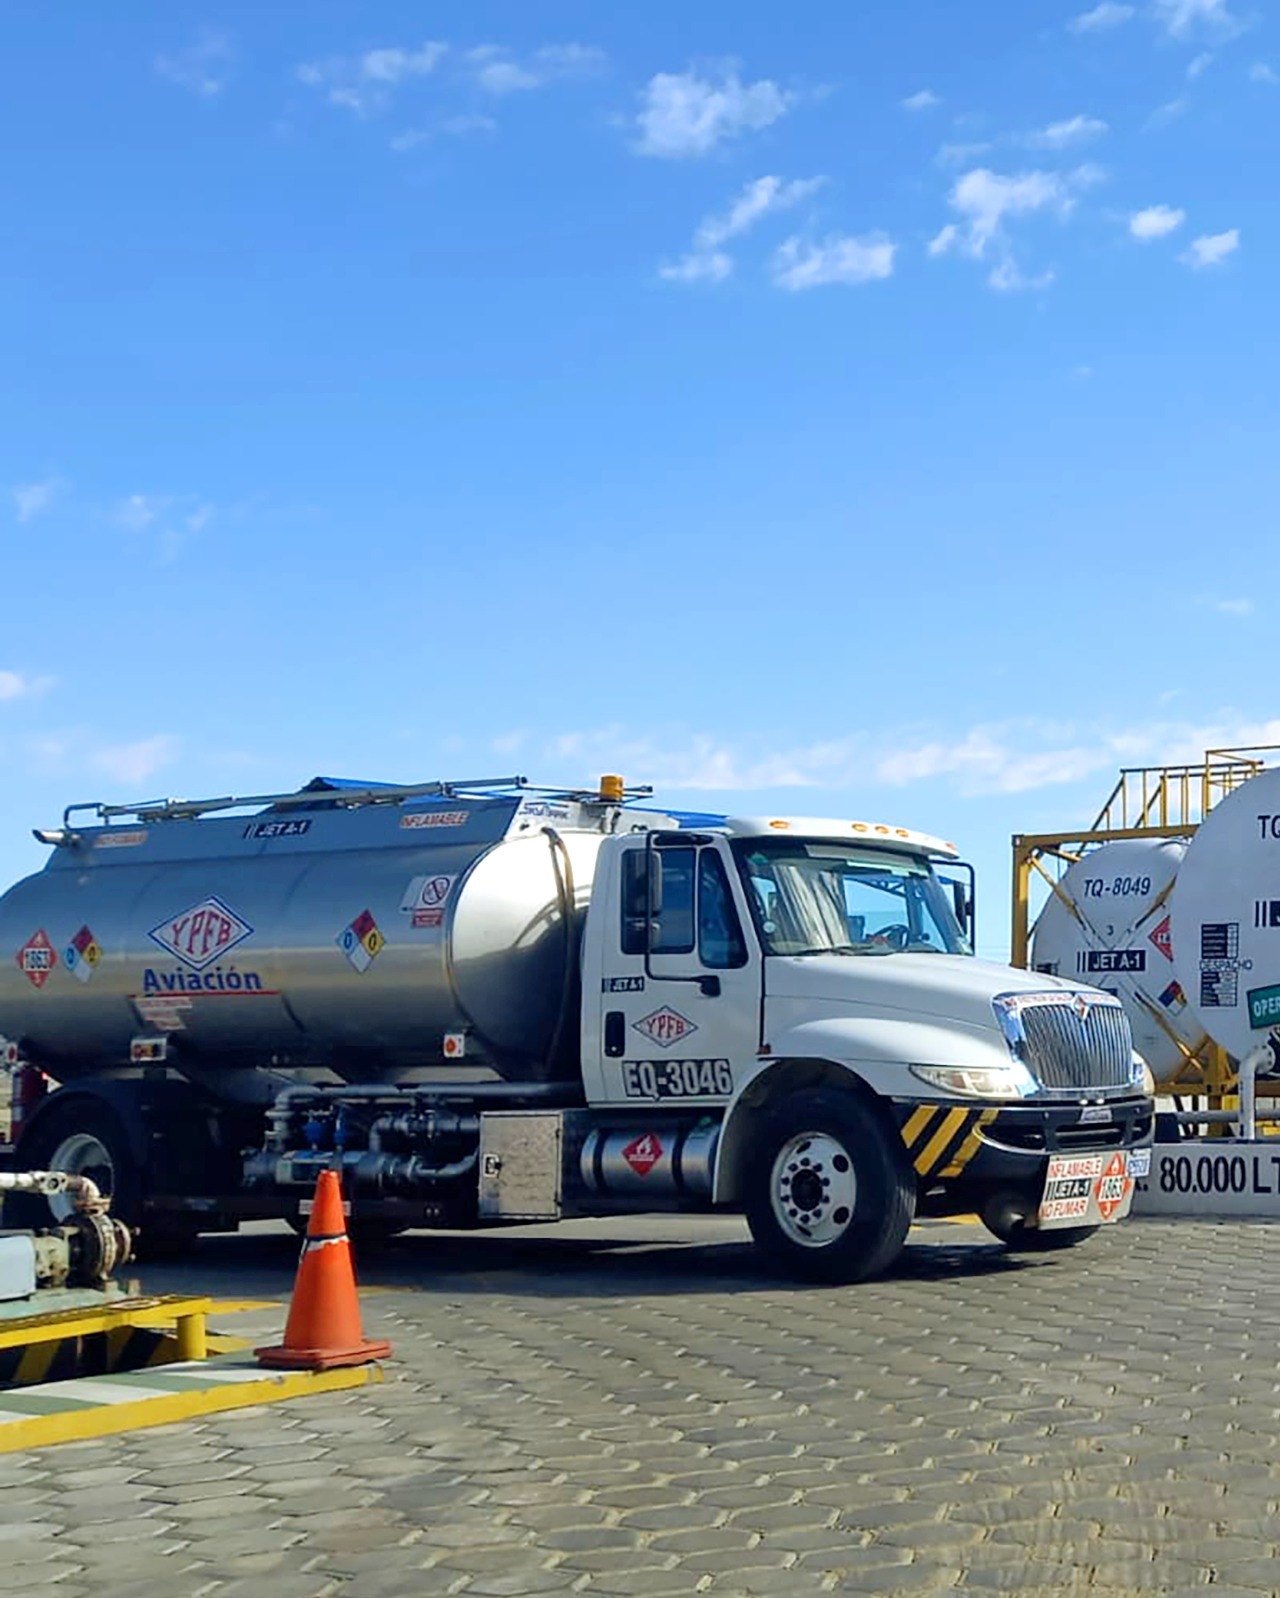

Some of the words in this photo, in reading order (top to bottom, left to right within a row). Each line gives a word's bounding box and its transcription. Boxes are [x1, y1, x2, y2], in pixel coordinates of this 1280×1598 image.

[1084, 877, 1151, 897] TQ-8049
[172, 910, 232, 956] YPFB
[1093, 954, 1118, 969] JET
[1118, 953, 1142, 969] A-1
[143, 966, 262, 992] Aviación
[646, 1014, 685, 1039] YPFB
[622, 1060, 734, 1101] EQ-3046
[1160, 1156, 1247, 1194] 80.000
